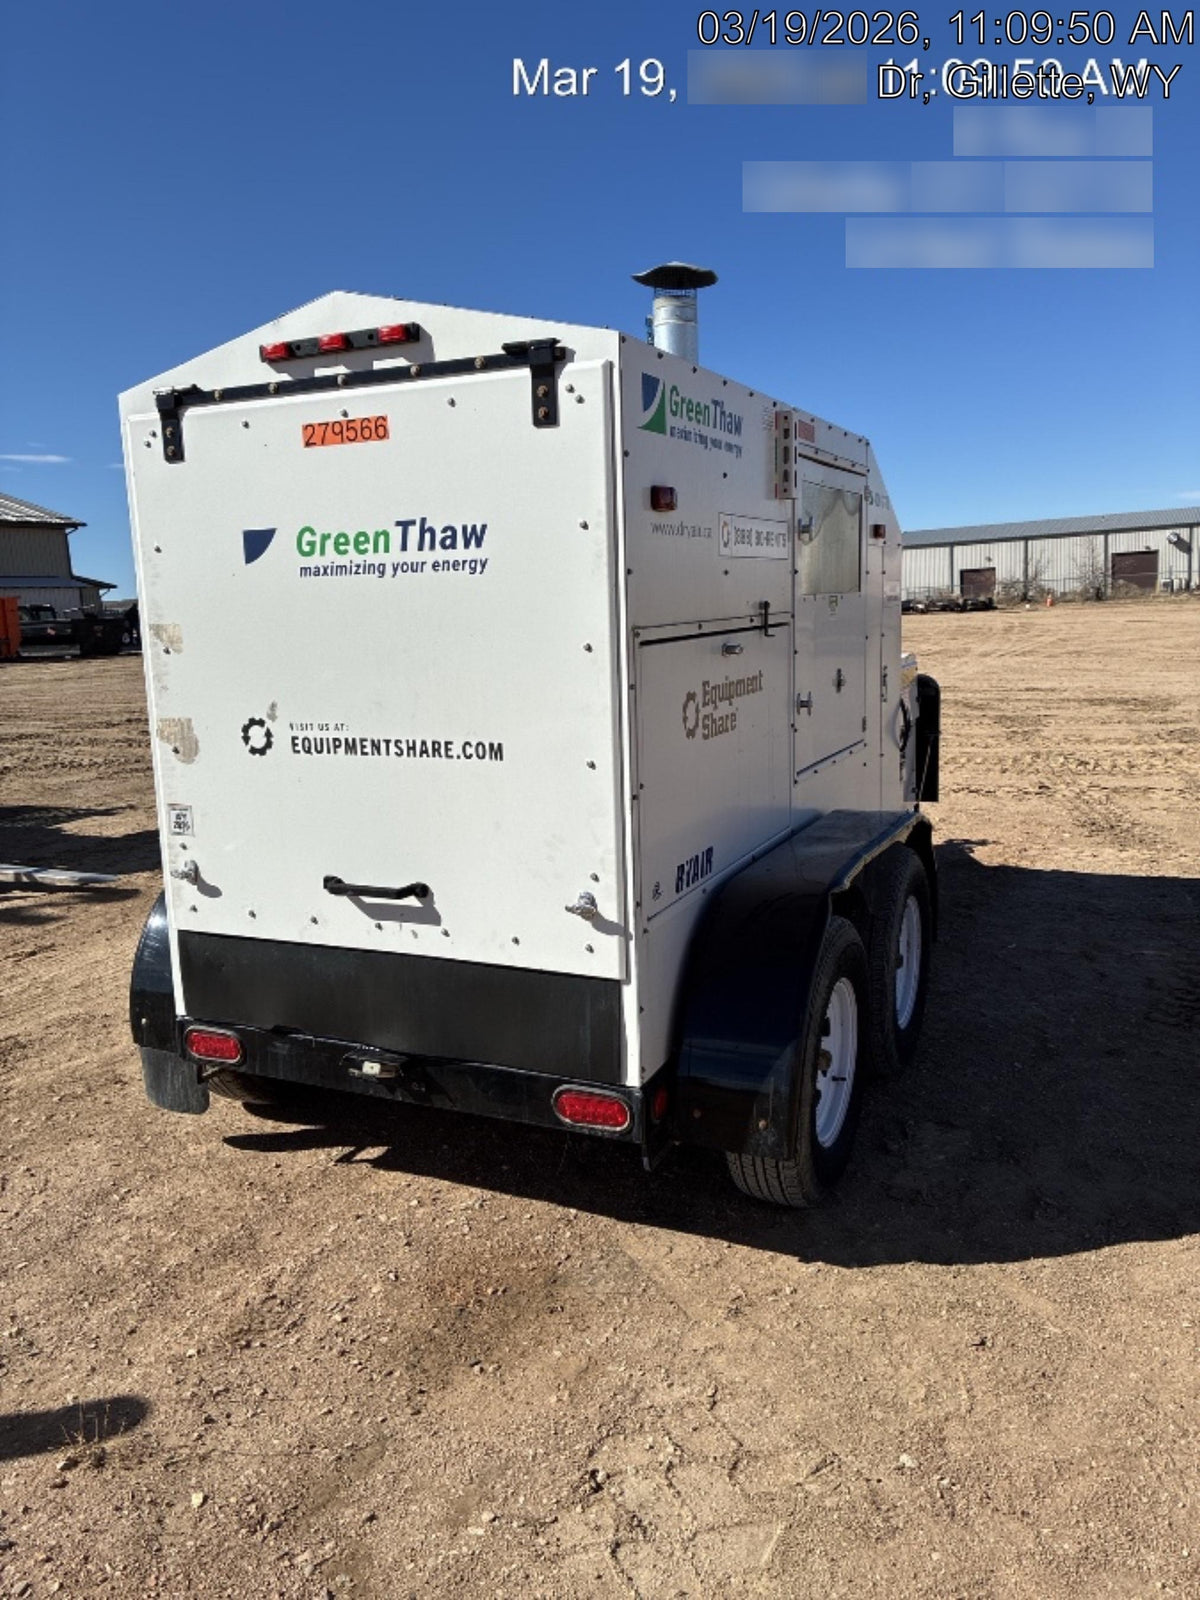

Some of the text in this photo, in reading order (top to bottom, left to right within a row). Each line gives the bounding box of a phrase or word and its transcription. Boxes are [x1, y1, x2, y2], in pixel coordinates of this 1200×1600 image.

[669, 384, 744, 438] GreenThaw
[303, 415, 388, 448] 279566
[296, 516, 488, 558] GreenThaw
[299, 556, 489, 578] maximizing your energy
[702, 669, 764, 711] Equipment
[289, 722, 314, 732] VISIT
[317, 722, 330, 732] US
[702, 711, 738, 740] Share
[291, 735, 505, 762] EQUIPMENTSHARE.COM
